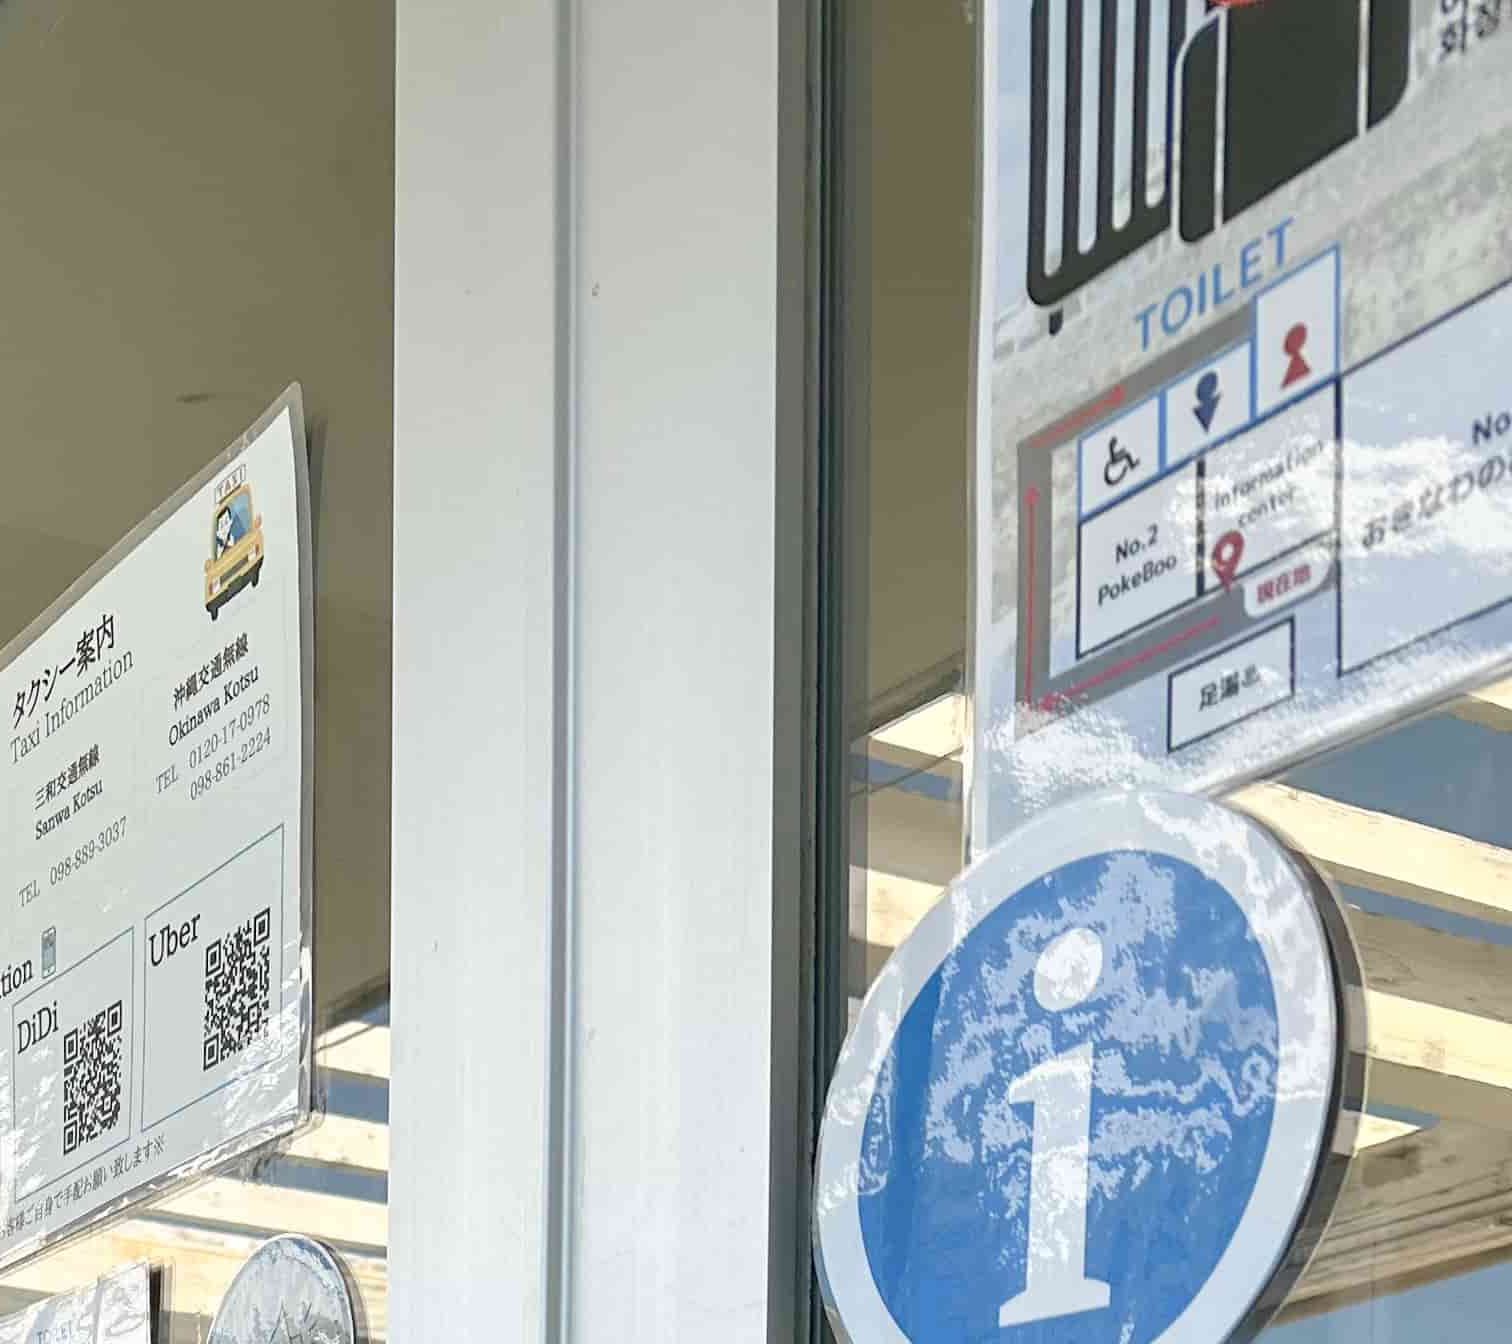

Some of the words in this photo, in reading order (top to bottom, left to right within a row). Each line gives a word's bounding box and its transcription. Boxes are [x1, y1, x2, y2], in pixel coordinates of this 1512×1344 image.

[1134, 215, 1296, 352] TOILET
[1097, 554, 1178, 606] PokeBoo
[1114, 523, 1159, 564] No.2
[10, 720, 41, 765] Taxi
[44, 650, 134, 738] Information
[13, 614, 115, 729] タクシー案内
[168, 696, 221, 747] Okinawa
[223, 665, 259, 707] Kotsu
[173, 632, 249, 712] 沖縄交通無線
[35, 744, 100, 811] 三和交通無線
[155, 764, 179, 794] TEL
[189, 693, 271, 769] 0120-17-0978
[190, 727, 272, 801] 098-861-2224
[35, 805, 70, 841] Sanwa
[72, 779, 103, 814] Kotsu
[19, 879, 41, 907] TEL
[49, 816, 128, 886] 098-889-3037
[148, 913, 201, 967] Uber
[16, 1001, 59, 1055] DiDi
